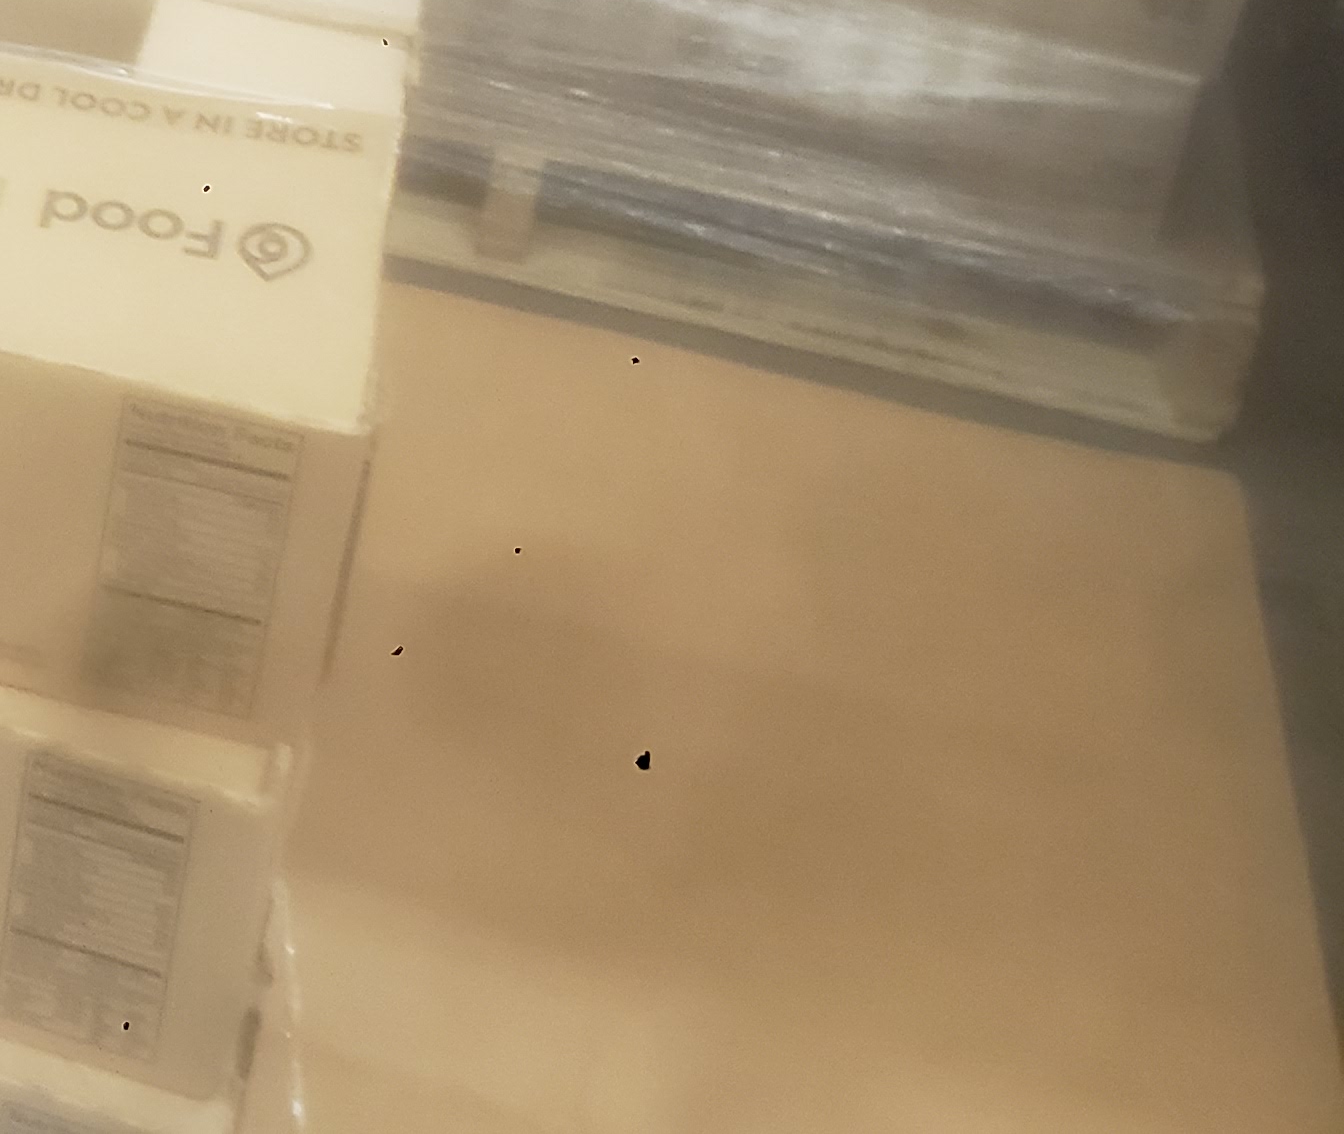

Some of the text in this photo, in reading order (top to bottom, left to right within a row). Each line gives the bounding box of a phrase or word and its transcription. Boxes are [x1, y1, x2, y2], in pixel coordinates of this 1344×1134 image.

[54, 86, 151, 123] COOL
[163, 105, 187, 126] A
[194, 114, 233, 136] IN
[244, 119, 361, 153] STORE
[37, 189, 227, 261] Food
